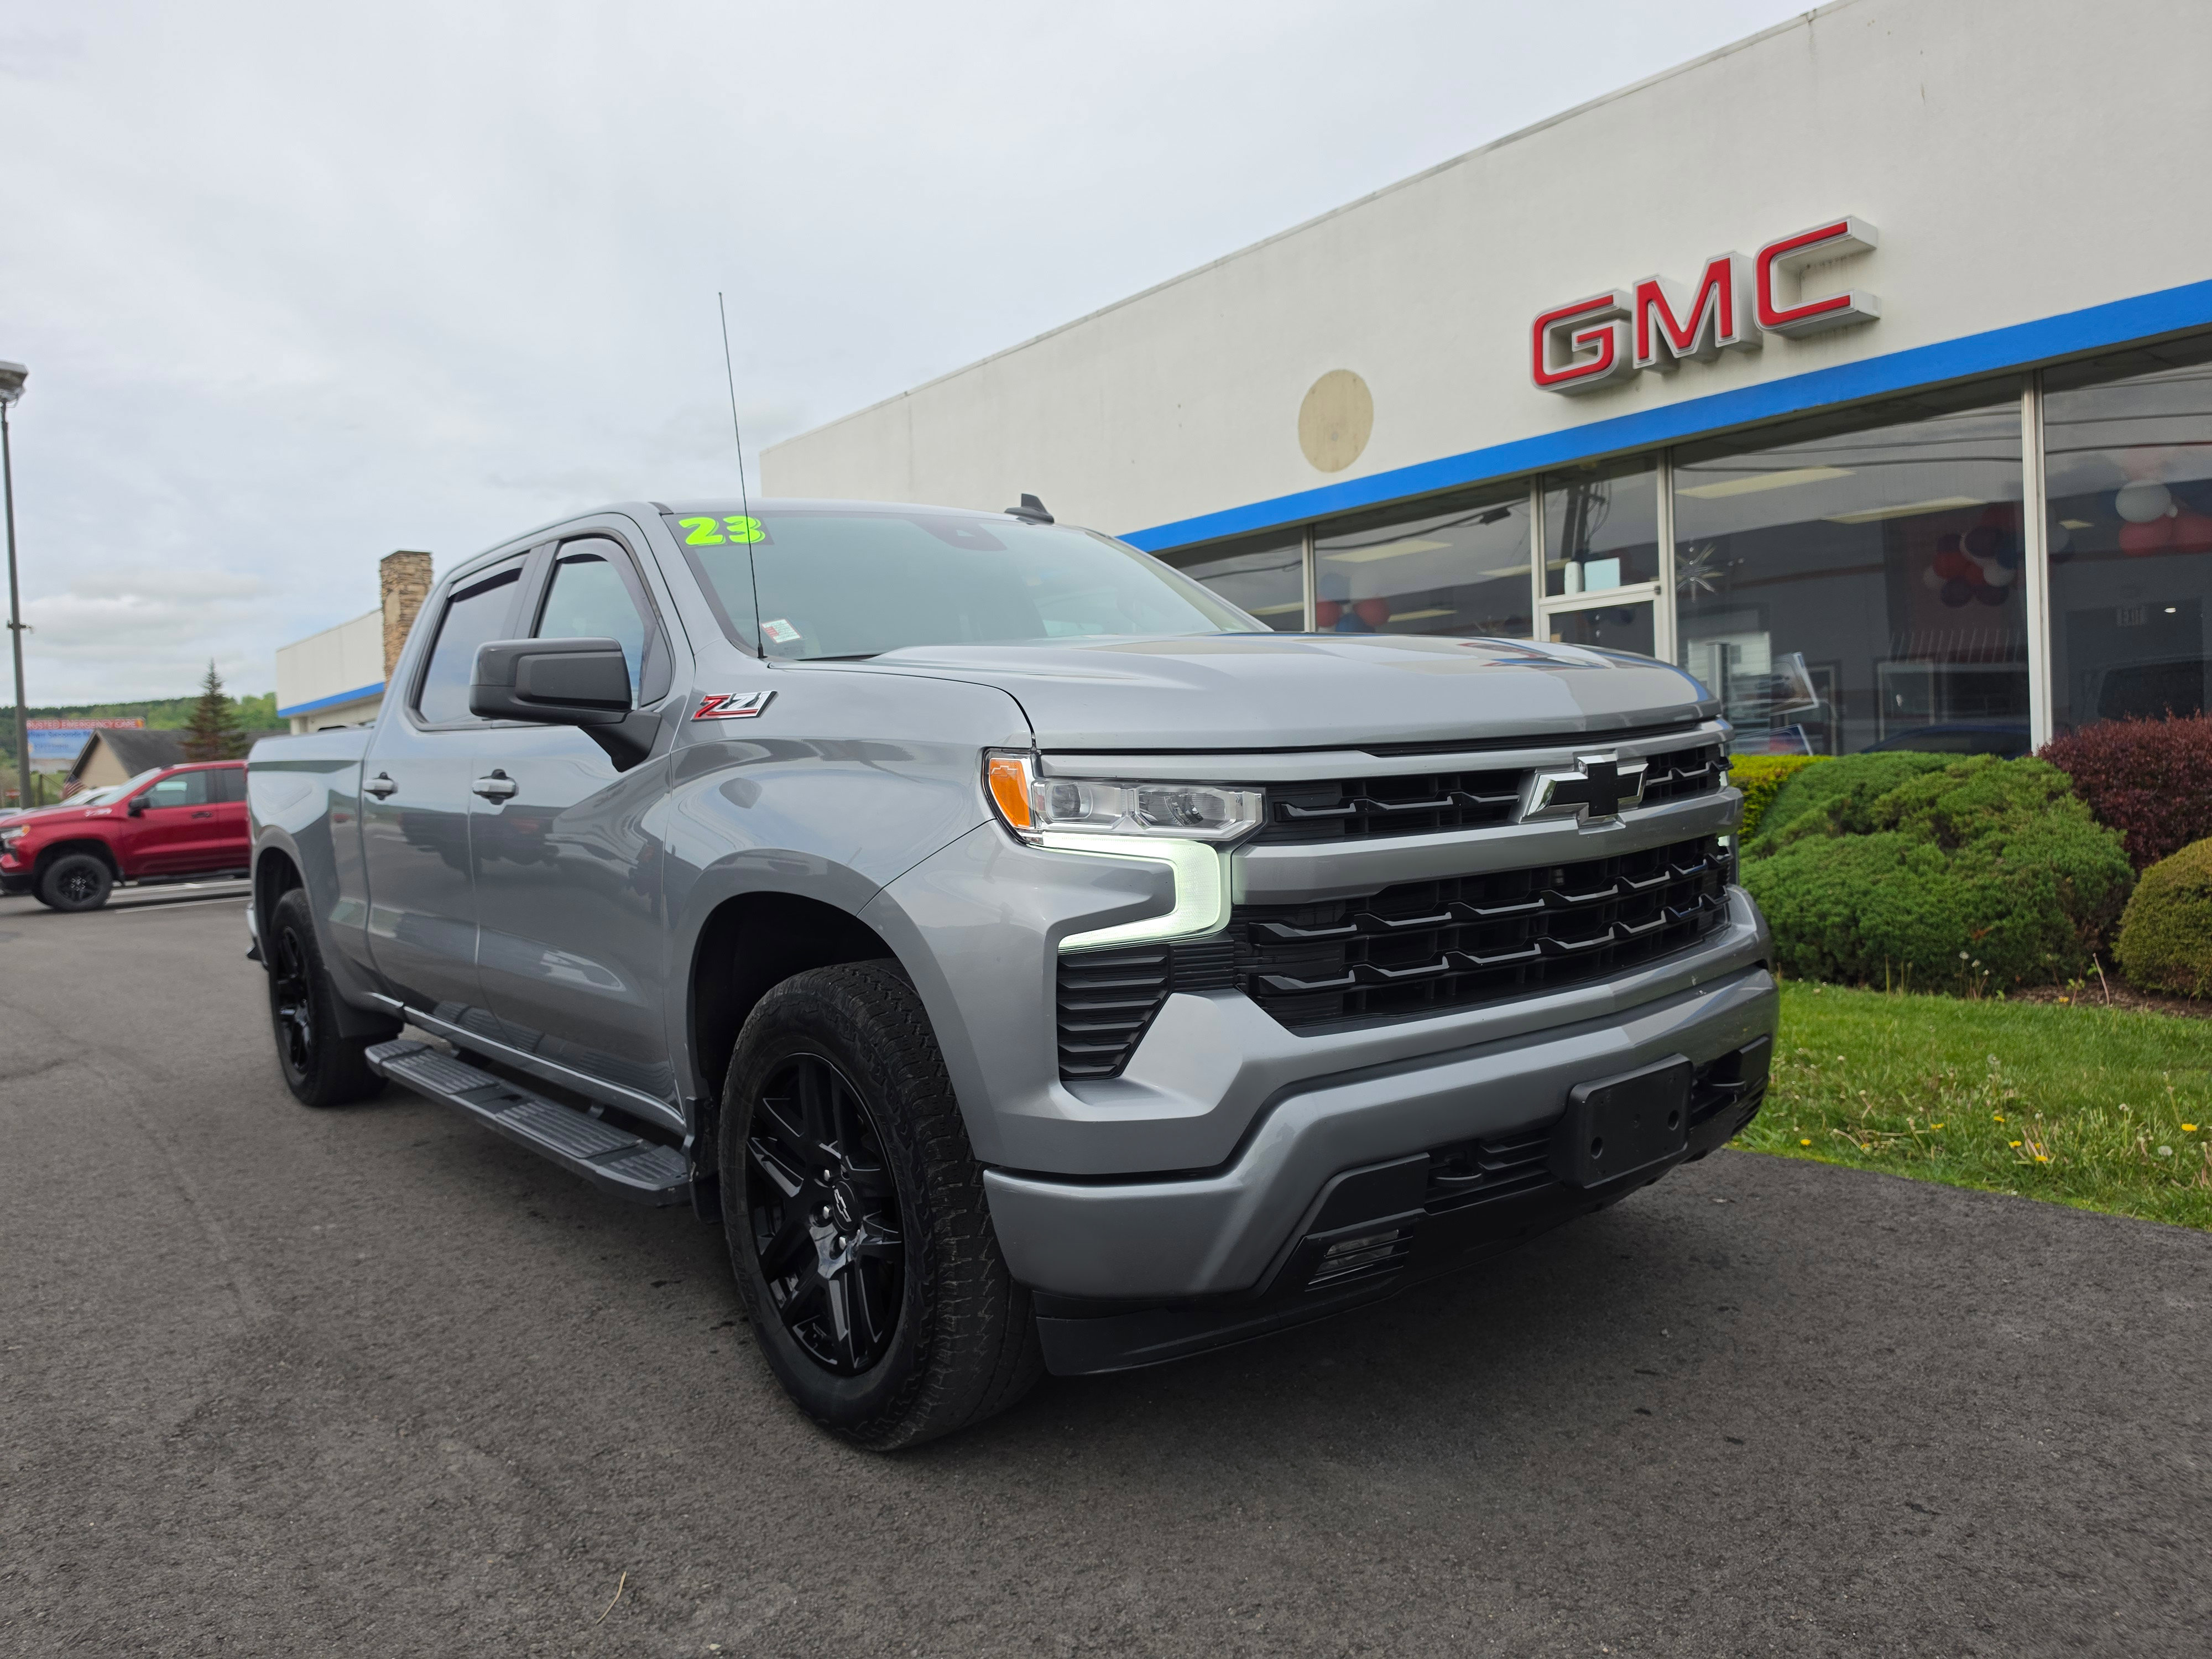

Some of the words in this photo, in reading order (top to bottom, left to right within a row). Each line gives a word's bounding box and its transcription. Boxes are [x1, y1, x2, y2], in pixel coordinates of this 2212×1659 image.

[1530, 215, 1858, 389] GMC
[679, 515, 766, 545] 23
[691, 691, 776, 722] Z71
[27, 720, 60, 729] RUSTED
[61, 719, 113, 728] EMERGENCY
[114, 719, 136, 728] CARE
